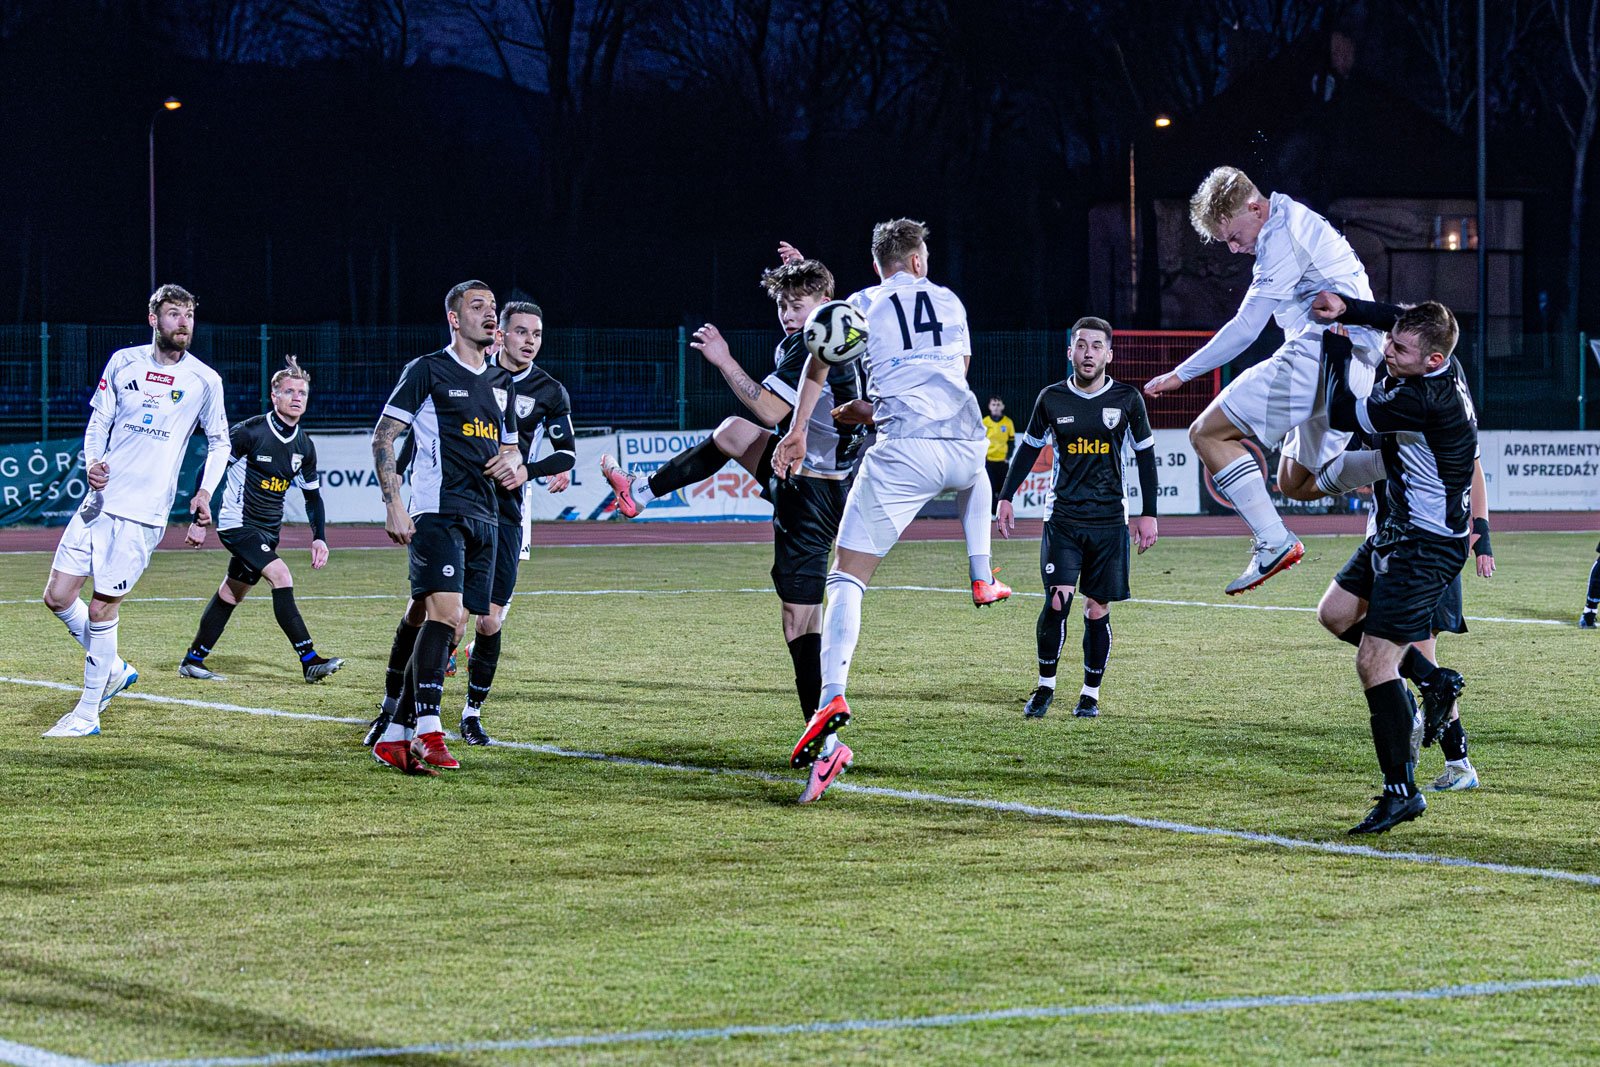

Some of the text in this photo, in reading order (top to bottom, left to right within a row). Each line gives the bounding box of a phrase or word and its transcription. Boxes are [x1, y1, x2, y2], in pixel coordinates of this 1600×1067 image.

[888, 291, 943, 351] 14
[147, 373, 173, 384] Betclic
[123, 423, 171, 438] PROMATIC
[548, 424, 564, 439] C
[626, 436, 706, 454] BUDOW
[1067, 437, 1110, 454] sikla
[1504, 444, 1600, 456] APARTAMENTY
[1167, 453, 1187, 466] 3D
[1506, 464, 1519, 476] W
[260, 477, 289, 492] sikl
[1017, 478, 1052, 496] piz
